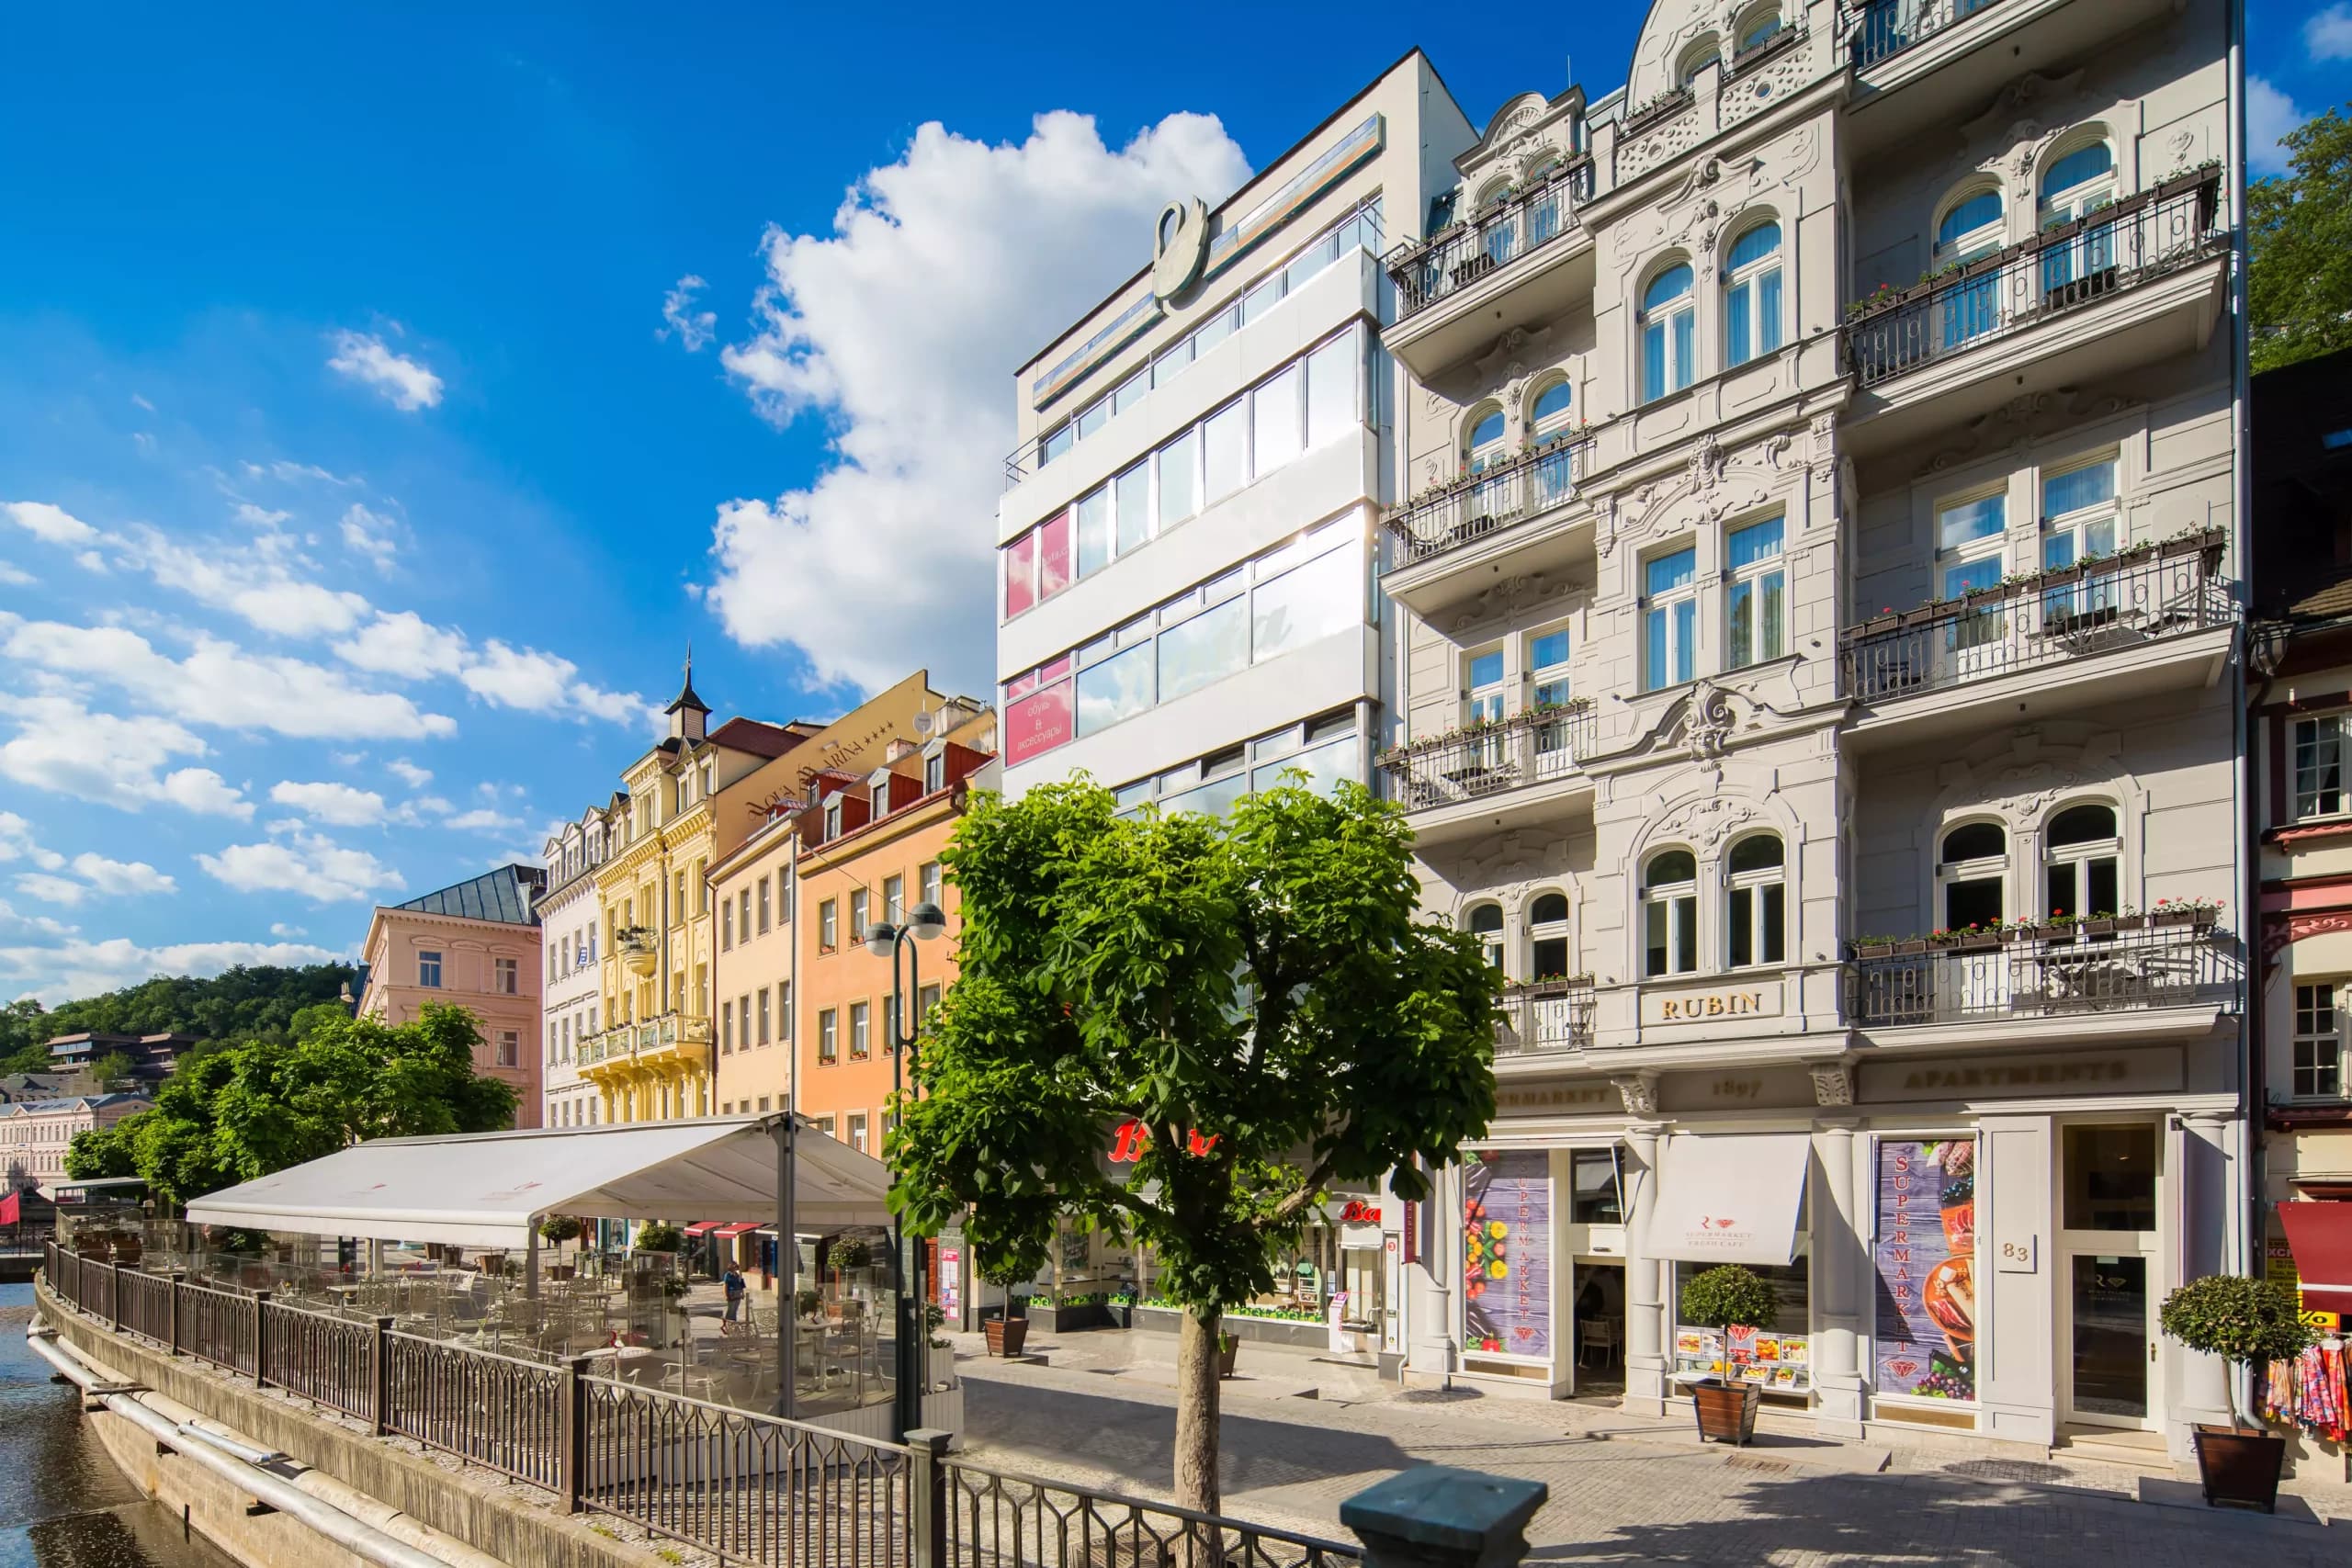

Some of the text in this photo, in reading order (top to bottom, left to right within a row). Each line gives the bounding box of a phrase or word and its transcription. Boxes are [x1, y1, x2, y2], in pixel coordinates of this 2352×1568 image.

[1661, 992, 1762, 1021] RUBIN
[1905, 1060, 2128, 1089] APARTMENTS
[1518, 1160, 1530, 1321] SUPERMARKET
[1893, 1155, 1911, 1354] SUPERMARKET
[2003, 1241, 2029, 1263] 83
